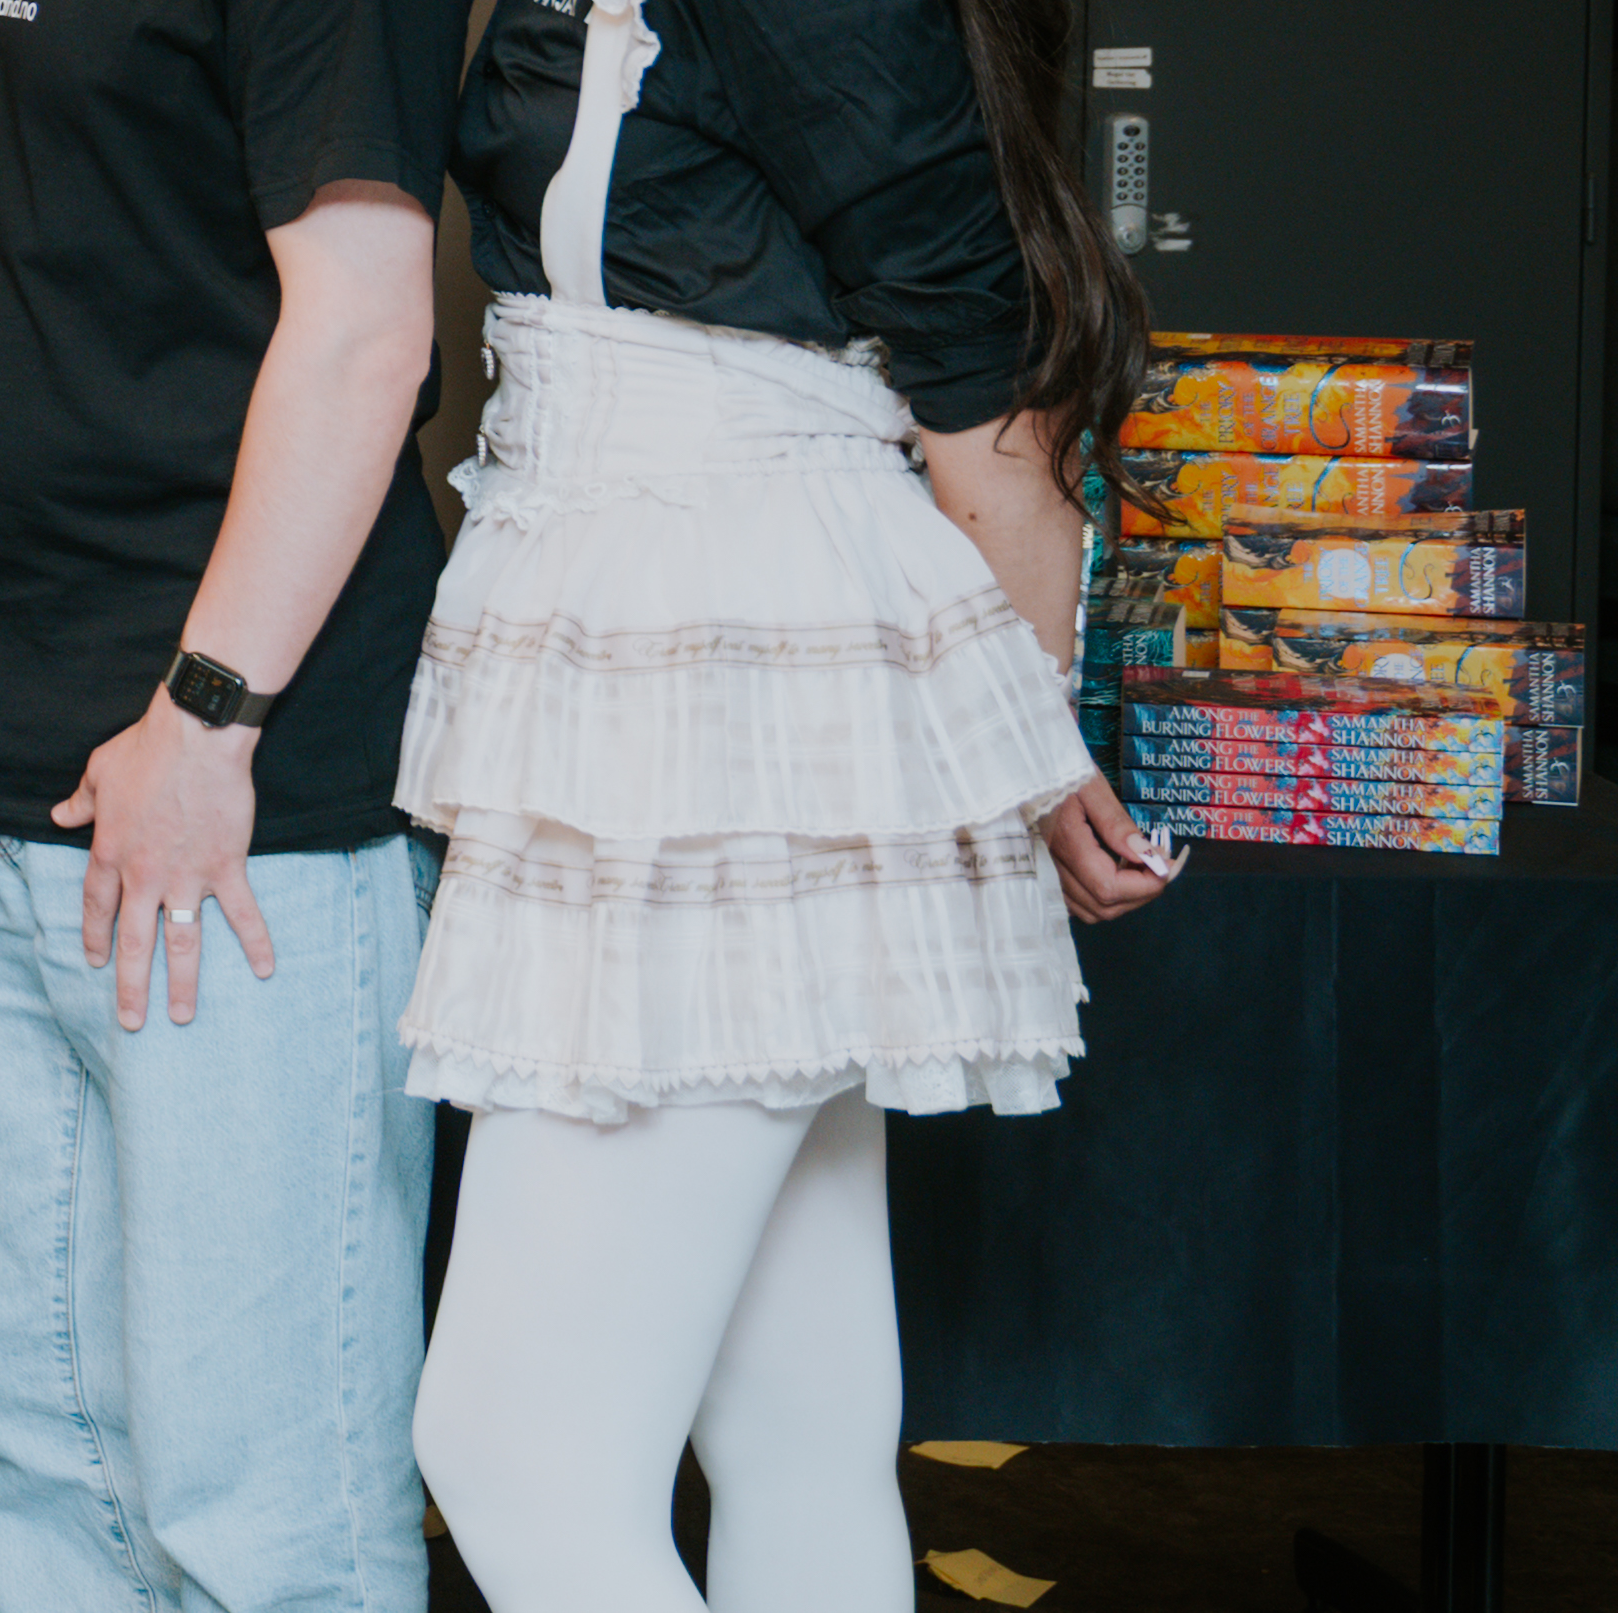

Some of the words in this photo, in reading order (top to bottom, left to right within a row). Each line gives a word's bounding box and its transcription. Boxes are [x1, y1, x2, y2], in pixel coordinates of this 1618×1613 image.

[1218, 380, 1236, 444] PRIORY
[1260, 376, 1279, 451] ORANGE
[1283, 392, 1303, 435] TREE
[1353, 379, 1369, 453] SAMANTHA
[1368, 378, 1384, 454] SHANNON
[1469, 547, 1483, 614] SAMANTHA
[1482, 546, 1497, 615] SHANNON
[1528, 651, 1541, 722] SAMANTHA
[1541, 652, 1556, 723] SHANNON
[1169, 705, 1233, 722] AMONG
[1237, 709, 1260, 722] THE
[1331, 714, 1426, 732] SAMANTHA
[1141, 720, 1212, 737] BURNING
[1216, 724, 1296, 742] FLOWERS
[1331, 729, 1426, 748] SHANNON
[1168, 739, 1233, 755] AMONG
[1236, 743, 1259, 755] THE
[1331, 748, 1425, 765] SAMANTHA
[1141, 753, 1211, 769] BURNING
[1215, 757, 1296, 775] FLOWERS
[1331, 762, 1425, 781] SHANNON
[1522, 729, 1534, 799] SAMANTHA
[1535, 729, 1550, 800] SHANNON
[1167, 772, 1232, 788] AMONG
[1236, 777, 1259, 789] THE
[1330, 781, 1424, 799] SAMANTHA
[1140, 787, 1210, 803] BURNING
[1215, 790, 1295, 809] FLOWERS
[1330, 796, 1424, 815] SHANNON
[1163, 806, 1227, 823] AMONG
[1231, 811, 1255, 823] THE
[1326, 815, 1420, 833] SAMANTHA
[1211, 824, 1291, 843] FLOWERS
[1326, 830, 1421, 850] SHANNON
